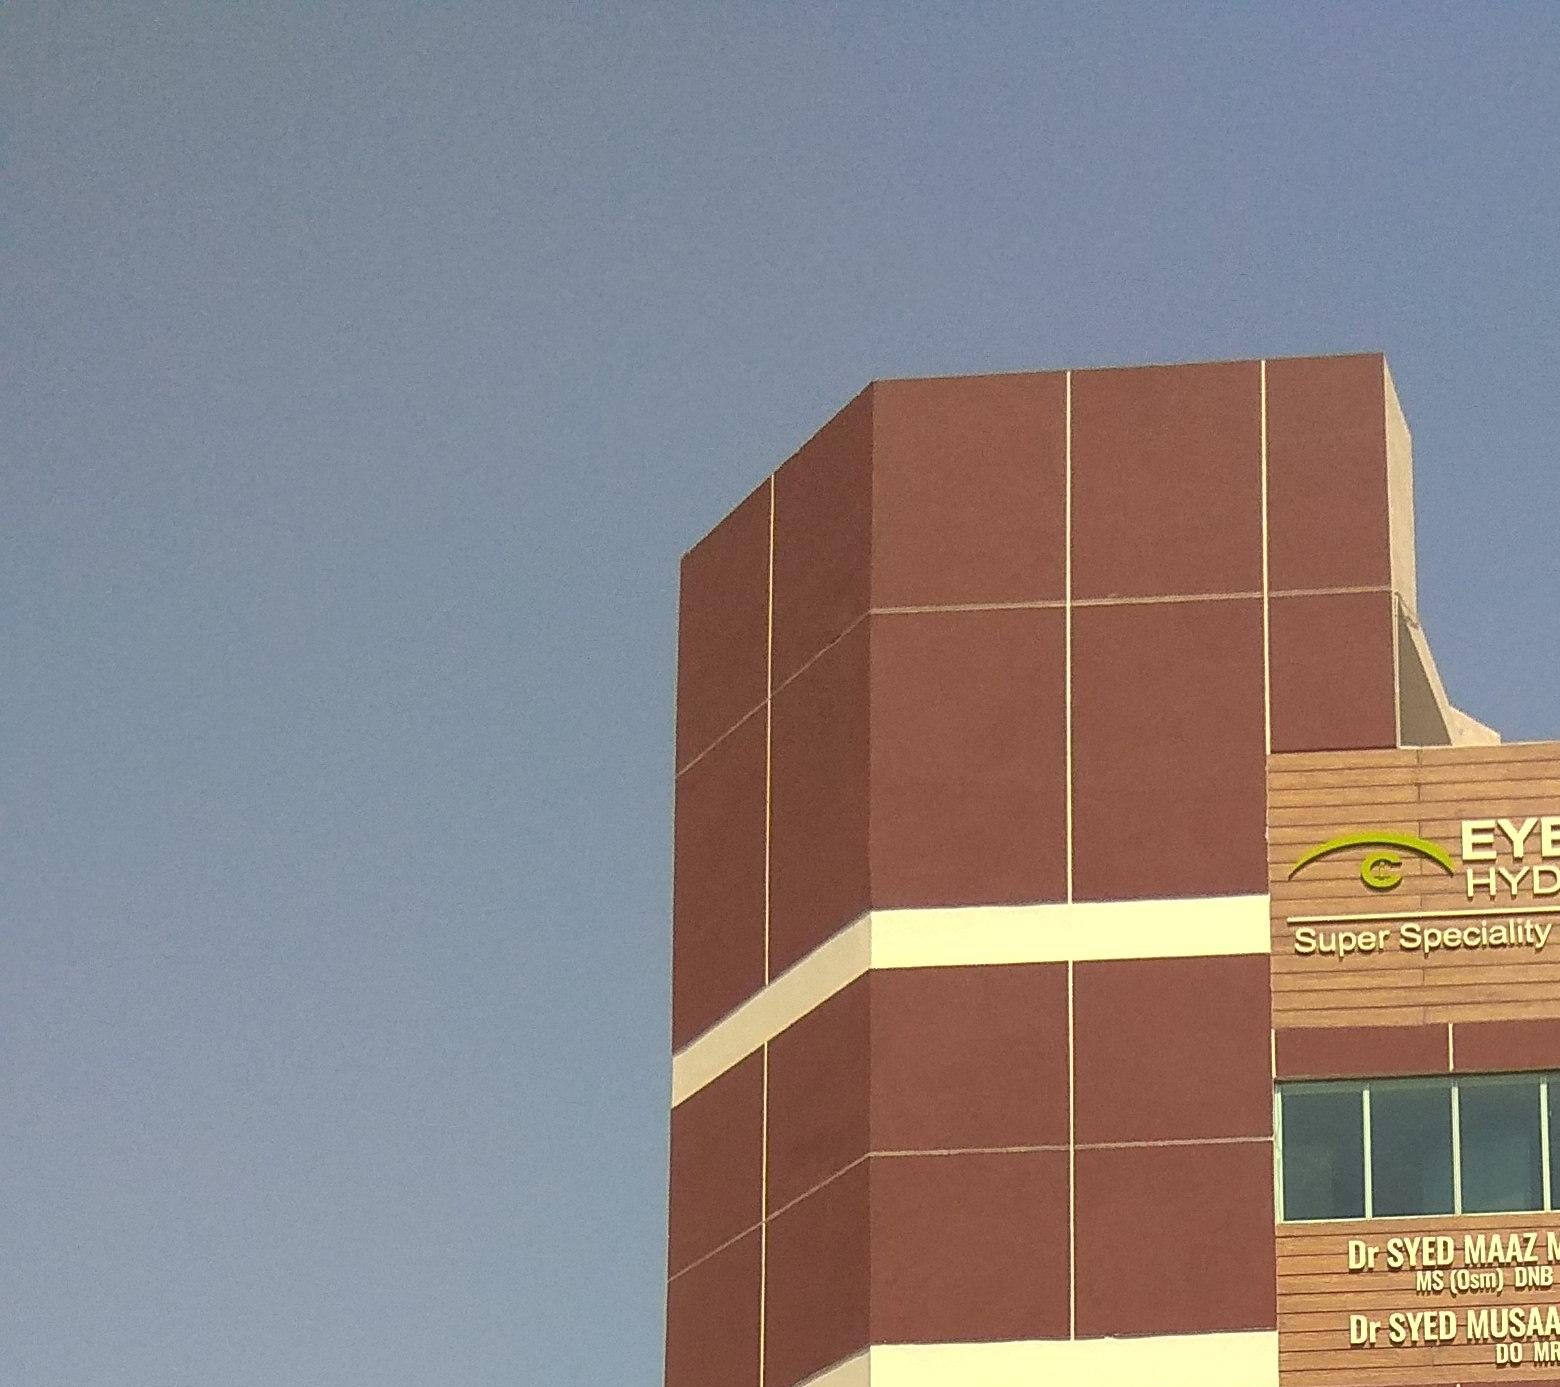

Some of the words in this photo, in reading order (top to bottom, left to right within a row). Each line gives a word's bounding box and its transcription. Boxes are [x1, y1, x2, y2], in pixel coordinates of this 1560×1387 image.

[1294, 927, 1390, 957] Super
[1399, 917, 1552, 954] Speciality
[1347, 1239, 1379, 1271] Dr
[1386, 1233, 1455, 1268] SYED
[1463, 1231, 1539, 1265] MAAZ
[1415, 1269, 1445, 1292] MS
[1449, 1265, 1504, 1293] (Osm)
[1514, 1263, 1553, 1288] DNB
[1349, 1314, 1383, 1345] Dr
[1389, 1309, 1457, 1343] SYED
[1495, 1341, 1523, 1364] DO
